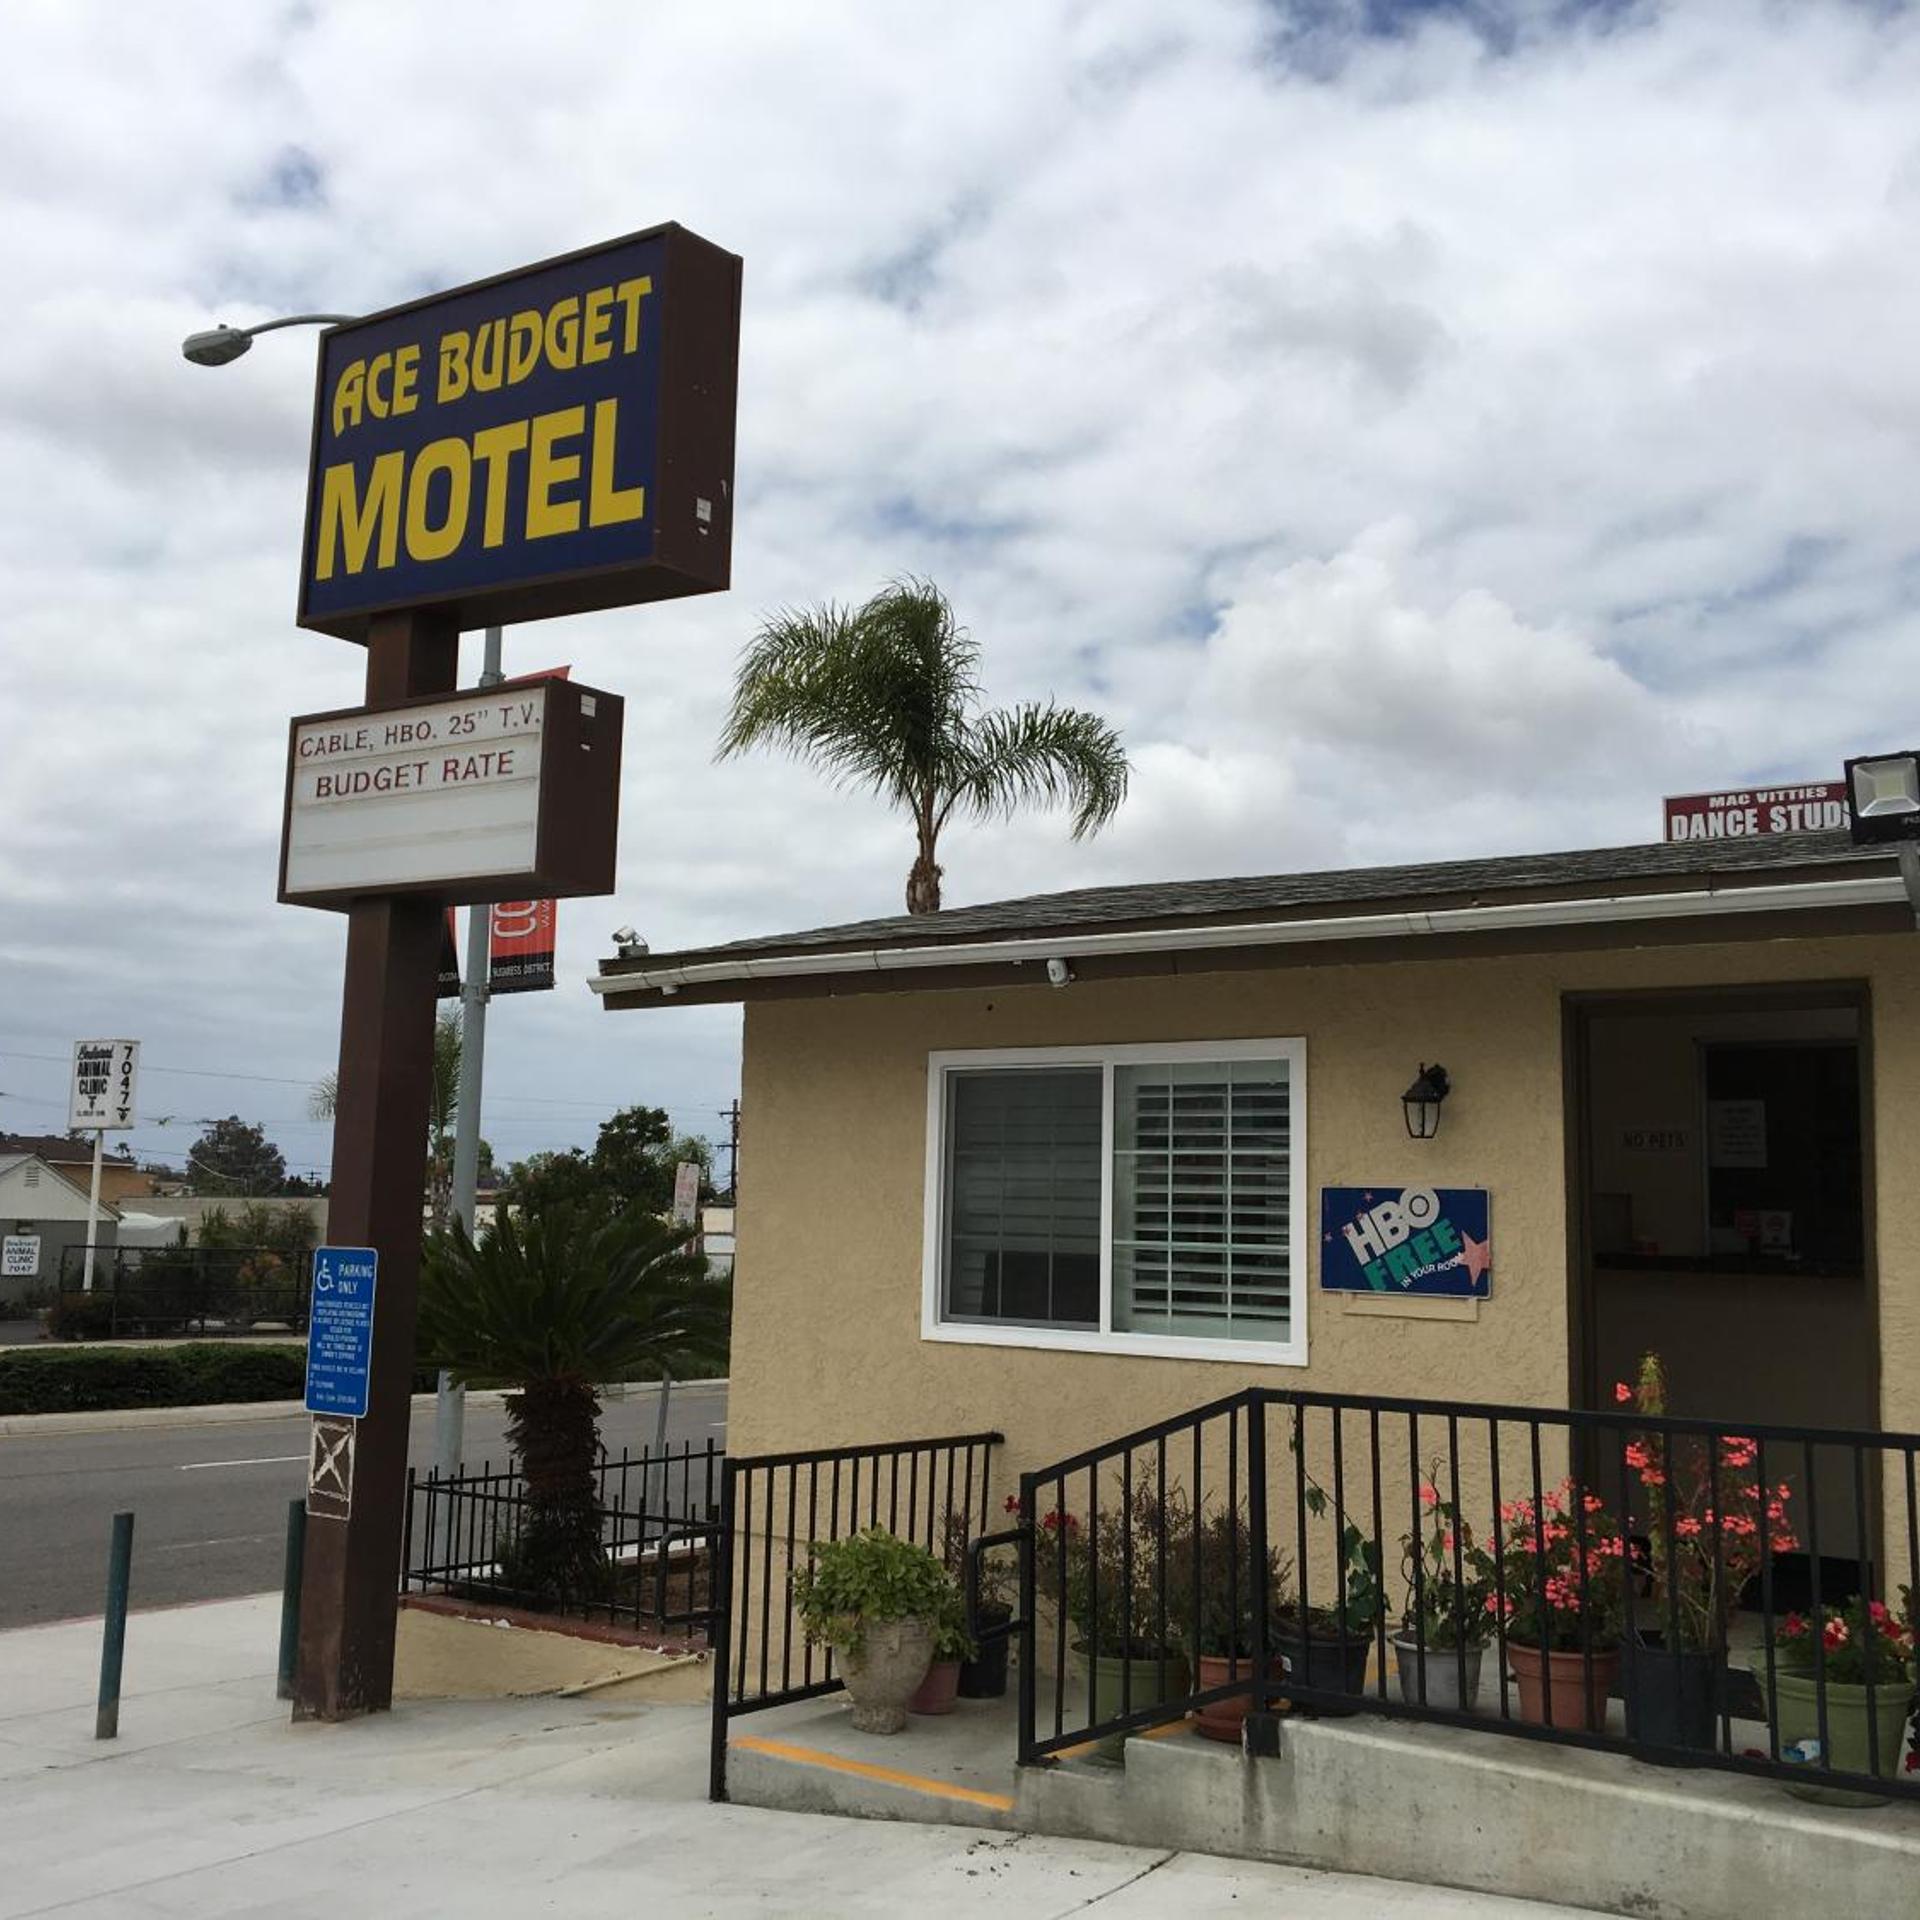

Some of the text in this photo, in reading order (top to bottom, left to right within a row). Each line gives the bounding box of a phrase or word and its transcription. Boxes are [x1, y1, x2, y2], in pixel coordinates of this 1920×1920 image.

[333, 276, 652, 438] ACE BUDGET
[315, 397, 645, 581] MOTEL
[300, 729, 374, 757] CABLE,
[316, 750, 514, 798] BUDGET RATE
[1709, 786, 1828, 809] MAC VITTIES
[1671, 799, 1851, 840] DANCE STUDI
[77, 1060, 110, 1077] ANIMAL
[120, 1045, 133, 1105] 7047
[79, 1078, 107, 1095] CLINIC
[1343, 1186, 1440, 1266] HBO
[7, 1255, 34, 1264] CLINIC
[1363, 1218, 1462, 1291] FREE
[338, 1263, 374, 1278] PARKING
[1400, 1276, 1412, 1288] IN
[1410, 1264, 1436, 1280] YOUR
[338, 1280, 358, 1295] ONLY
